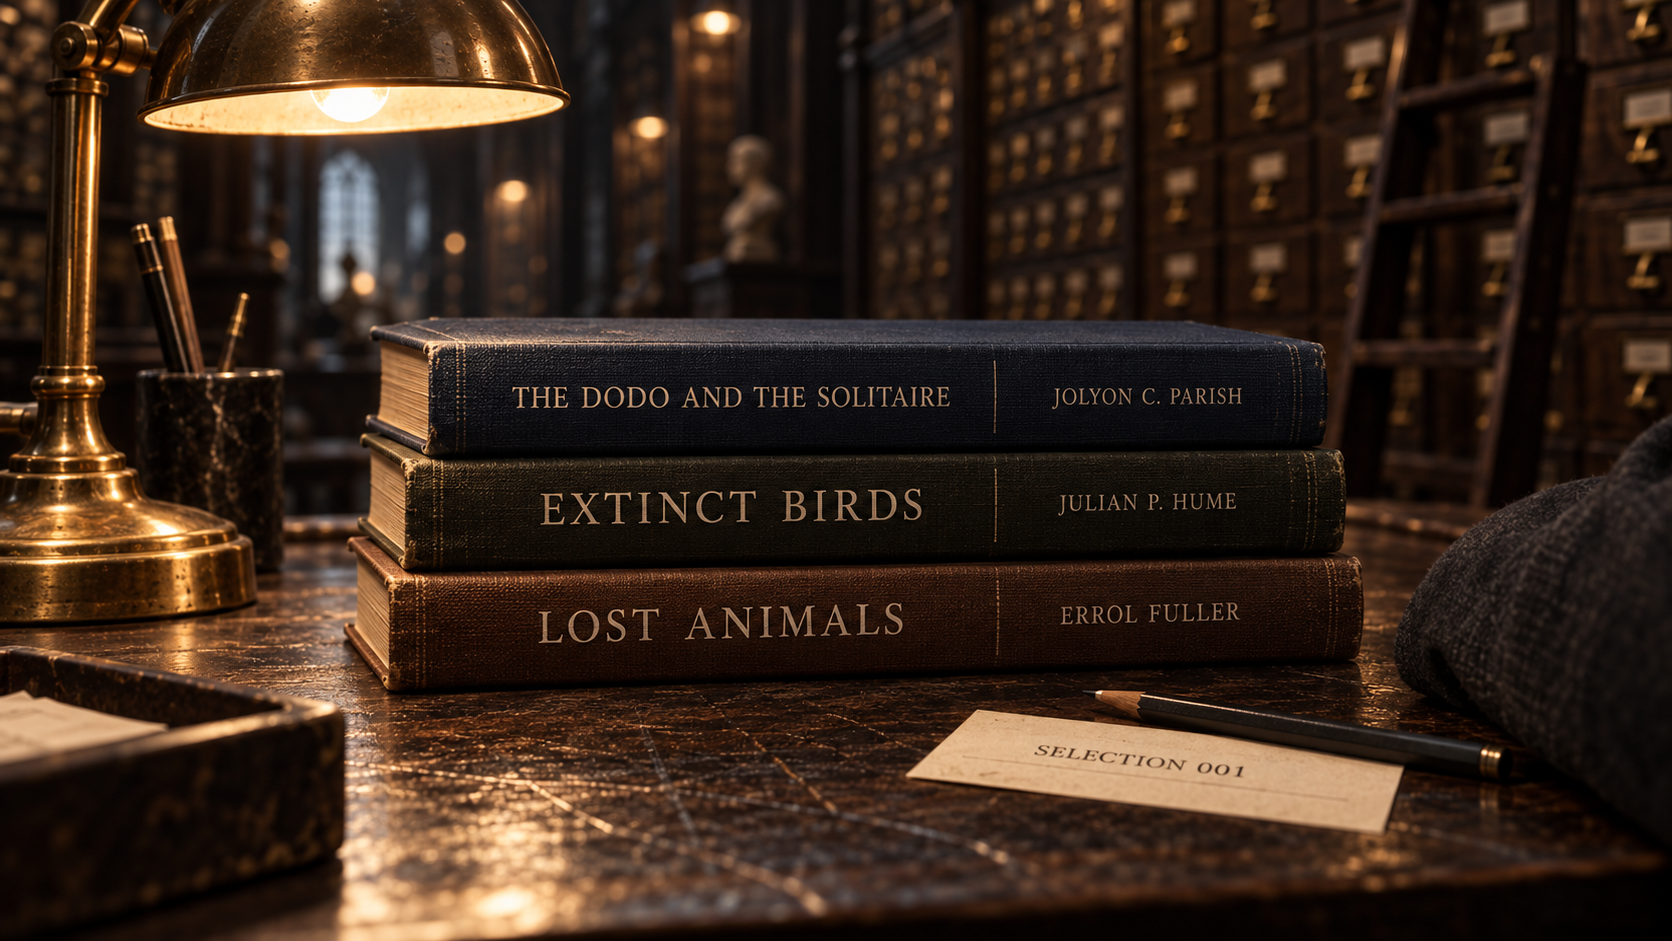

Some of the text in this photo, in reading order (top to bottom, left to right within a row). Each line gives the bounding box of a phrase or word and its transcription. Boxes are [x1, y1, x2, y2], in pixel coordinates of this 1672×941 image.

[512, 386, 950, 408] THE DODO AND THE SOLITAIRE
[1052, 387, 1242, 410] JOLYON C. PARISH
[540, 488, 923, 526] EXTINCT BIRDS
[1058, 492, 1237, 516] JULIAN P. HUME
[538, 602, 904, 644] LOST ANIMALS
[1060, 602, 1240, 625] ERROL FULLER
[1034, 744, 1245, 778] SELECTION 001
